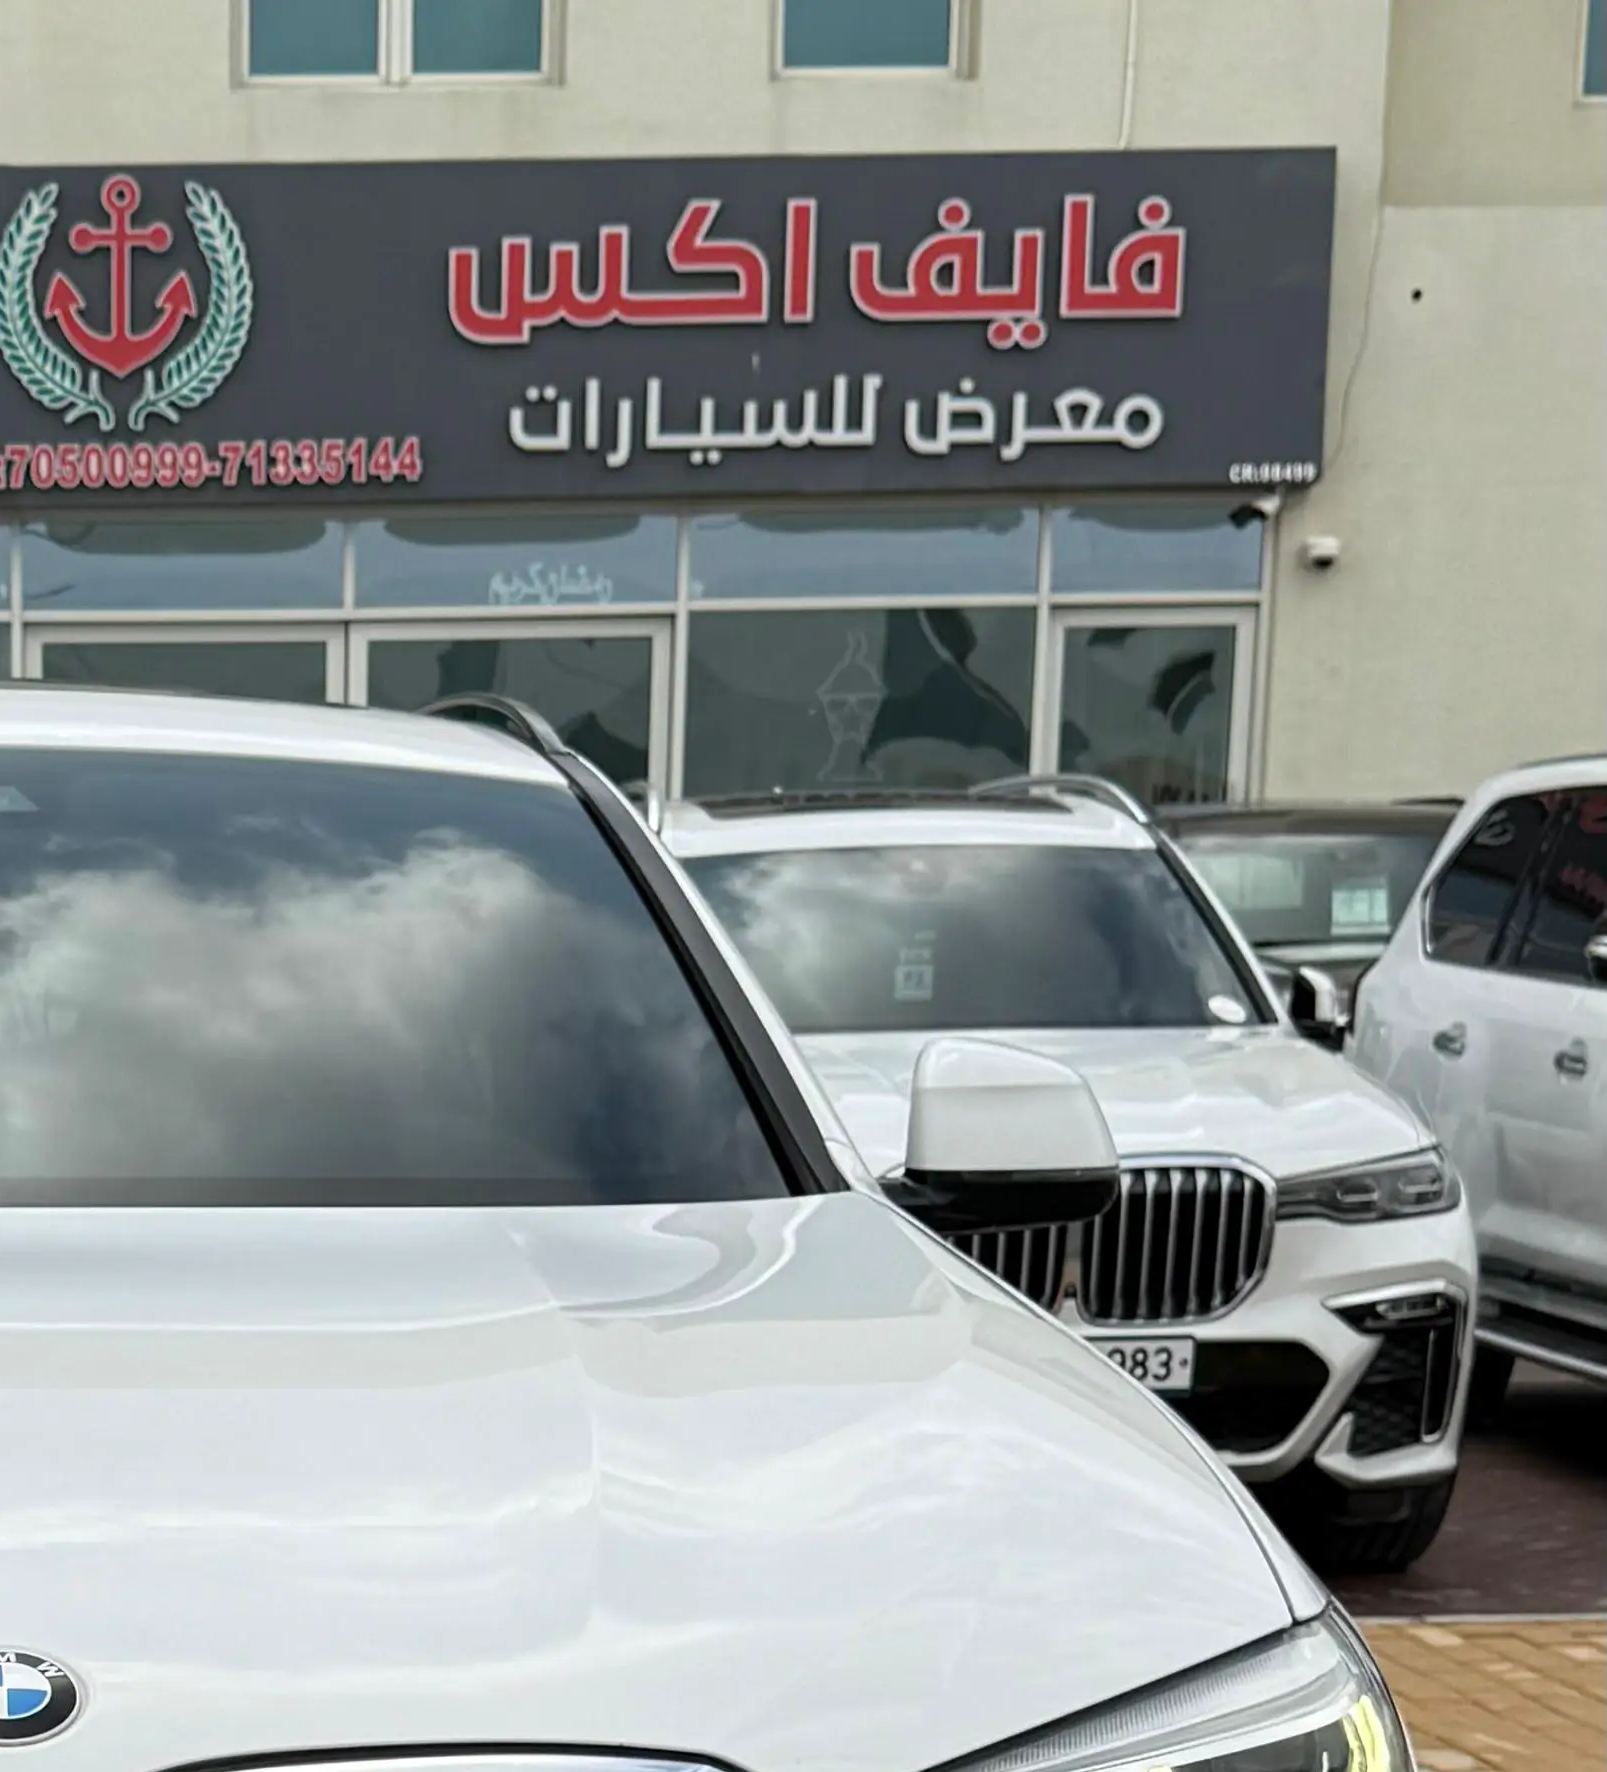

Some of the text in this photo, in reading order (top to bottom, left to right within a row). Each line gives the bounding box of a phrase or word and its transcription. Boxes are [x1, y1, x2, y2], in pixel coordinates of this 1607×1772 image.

[448, 193, 1187, 349] فايف اكس
[508, 373, 1164, 467] معرض للسيارات
